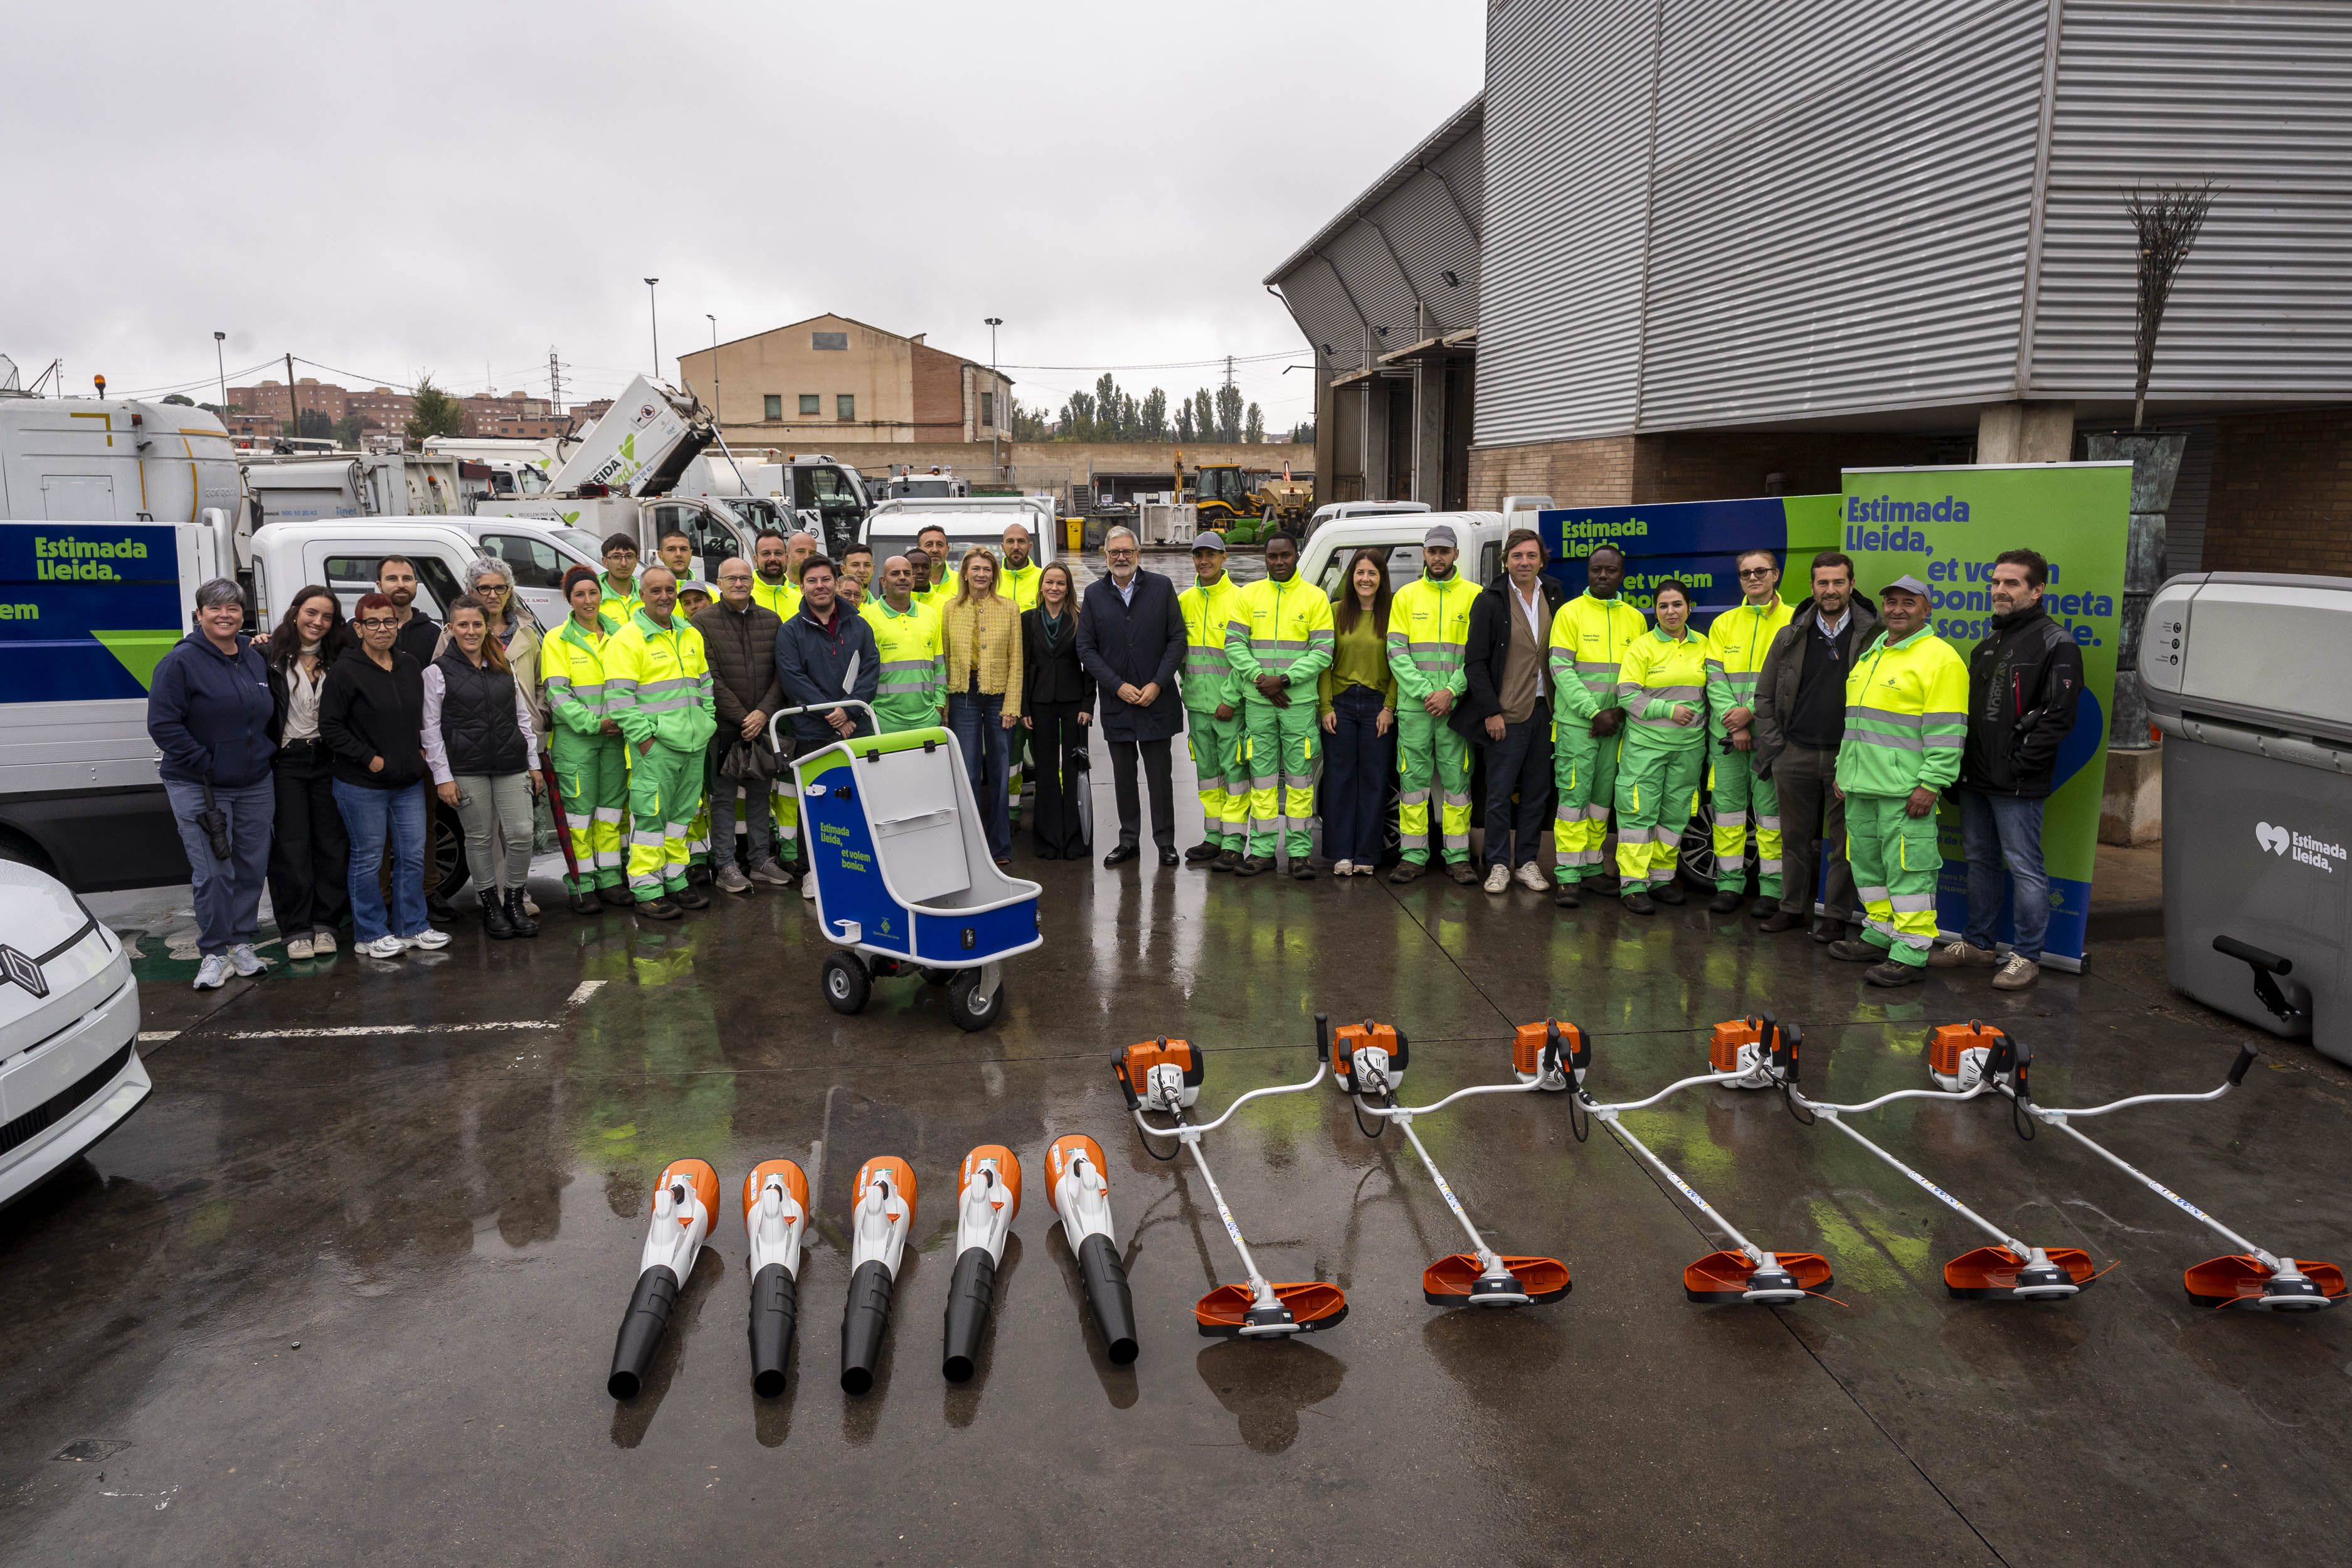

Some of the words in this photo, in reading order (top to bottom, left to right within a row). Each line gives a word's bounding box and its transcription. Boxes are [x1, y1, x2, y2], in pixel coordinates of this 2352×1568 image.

[593, 460, 622, 484] EIDA
[609, 460, 634, 485] erd
[1847, 494, 1969, 522] Estimada
[1562, 517, 1648, 538] Estimada
[35, 536, 148, 558] Estimada
[1845, 523, 1934, 557] Lleida,
[36, 558, 122, 583] Lleida.
[1623, 573, 1645, 590] et
[1927, 558, 1959, 583] et
[2042, 591, 2113, 617] neta
[820, 822, 850, 837] Estimada
[820, 832, 843, 847] Lleida,
[841, 849, 849, 858] et
[849, 850, 871, 862] volem
[2292, 831, 2347, 861] Estimada
[841, 858, 867, 873] bonica.
[2292, 846, 2333, 874] Lleida,
